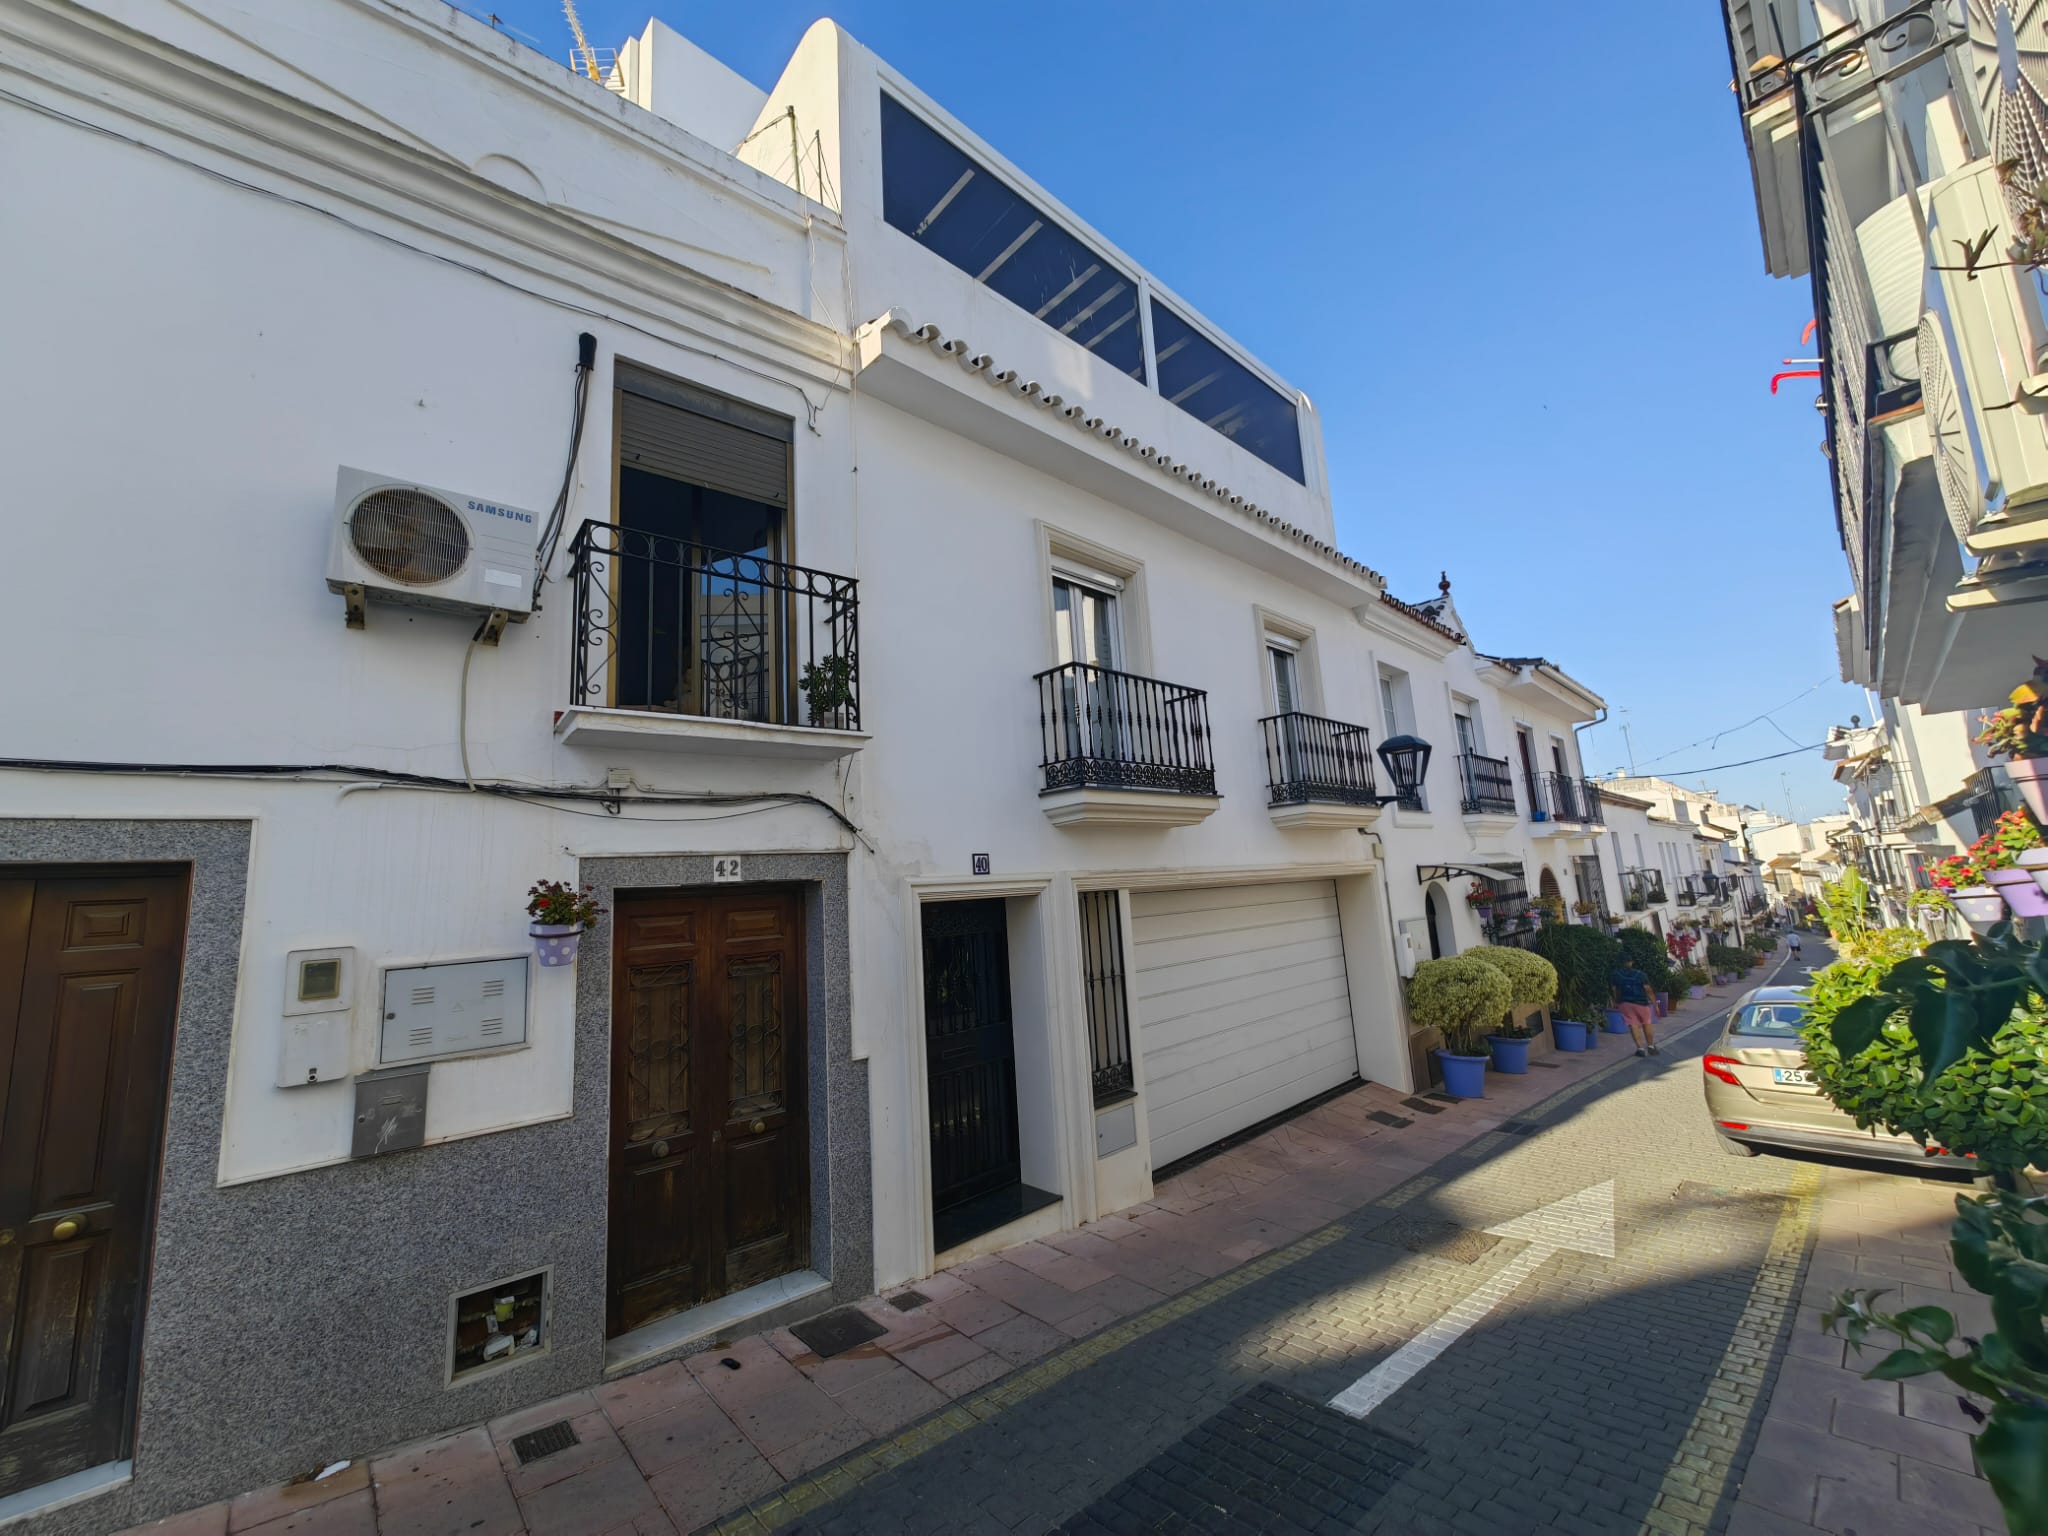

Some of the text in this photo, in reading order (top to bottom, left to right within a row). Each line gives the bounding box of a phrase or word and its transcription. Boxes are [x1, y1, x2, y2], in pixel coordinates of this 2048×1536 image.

[467, 500, 532, 523] SAMSUNG
[715, 859, 739, 877] 42
[975, 856, 988, 872] 40
